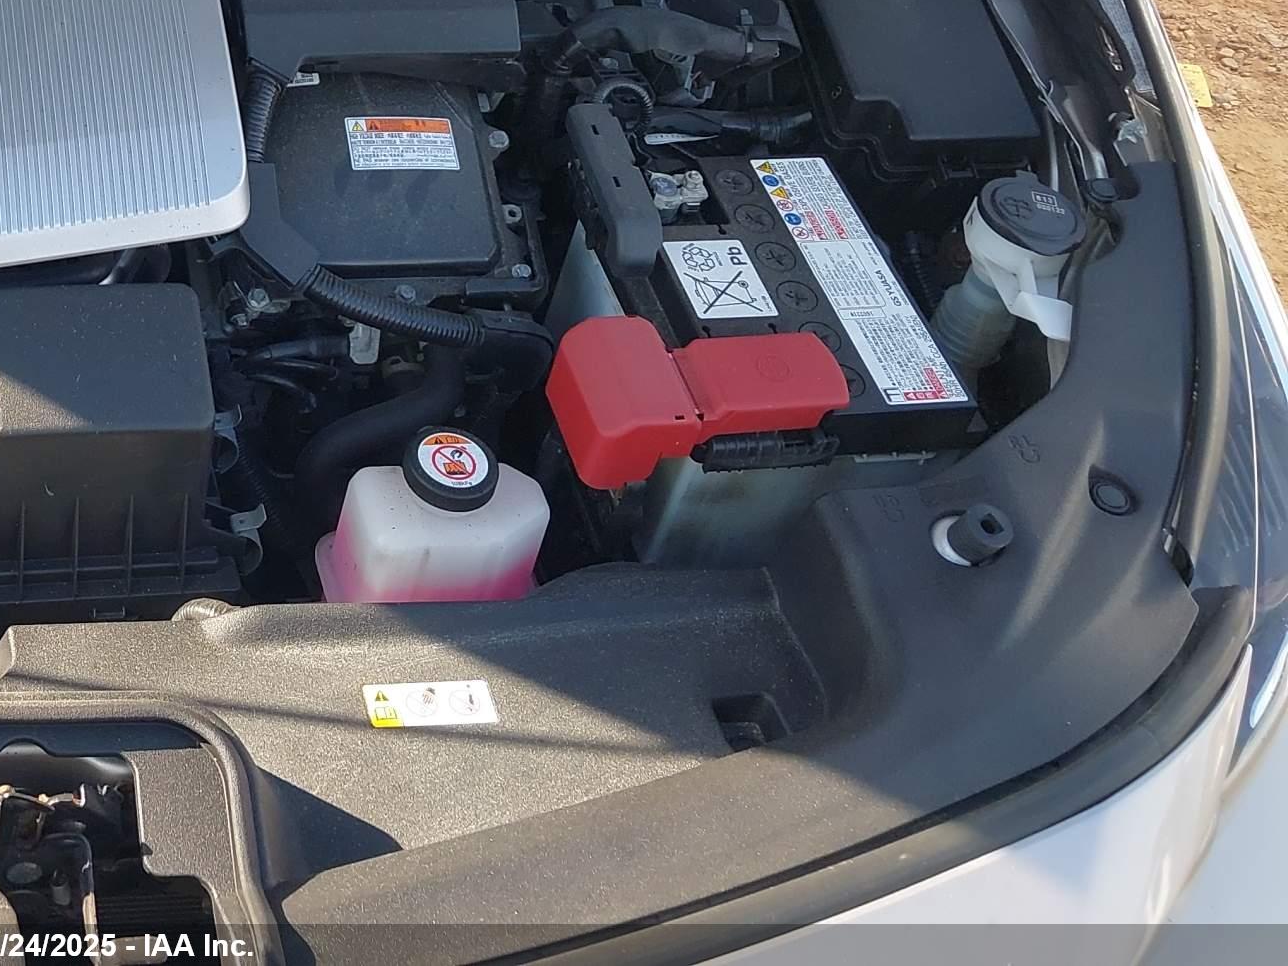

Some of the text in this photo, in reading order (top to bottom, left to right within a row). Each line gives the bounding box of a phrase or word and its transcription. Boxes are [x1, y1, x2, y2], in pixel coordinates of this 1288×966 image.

[727, 247, 747, 265] Pb
[874, 269, 895, 295] YUASA
[890, 295, 902, 307] GS
